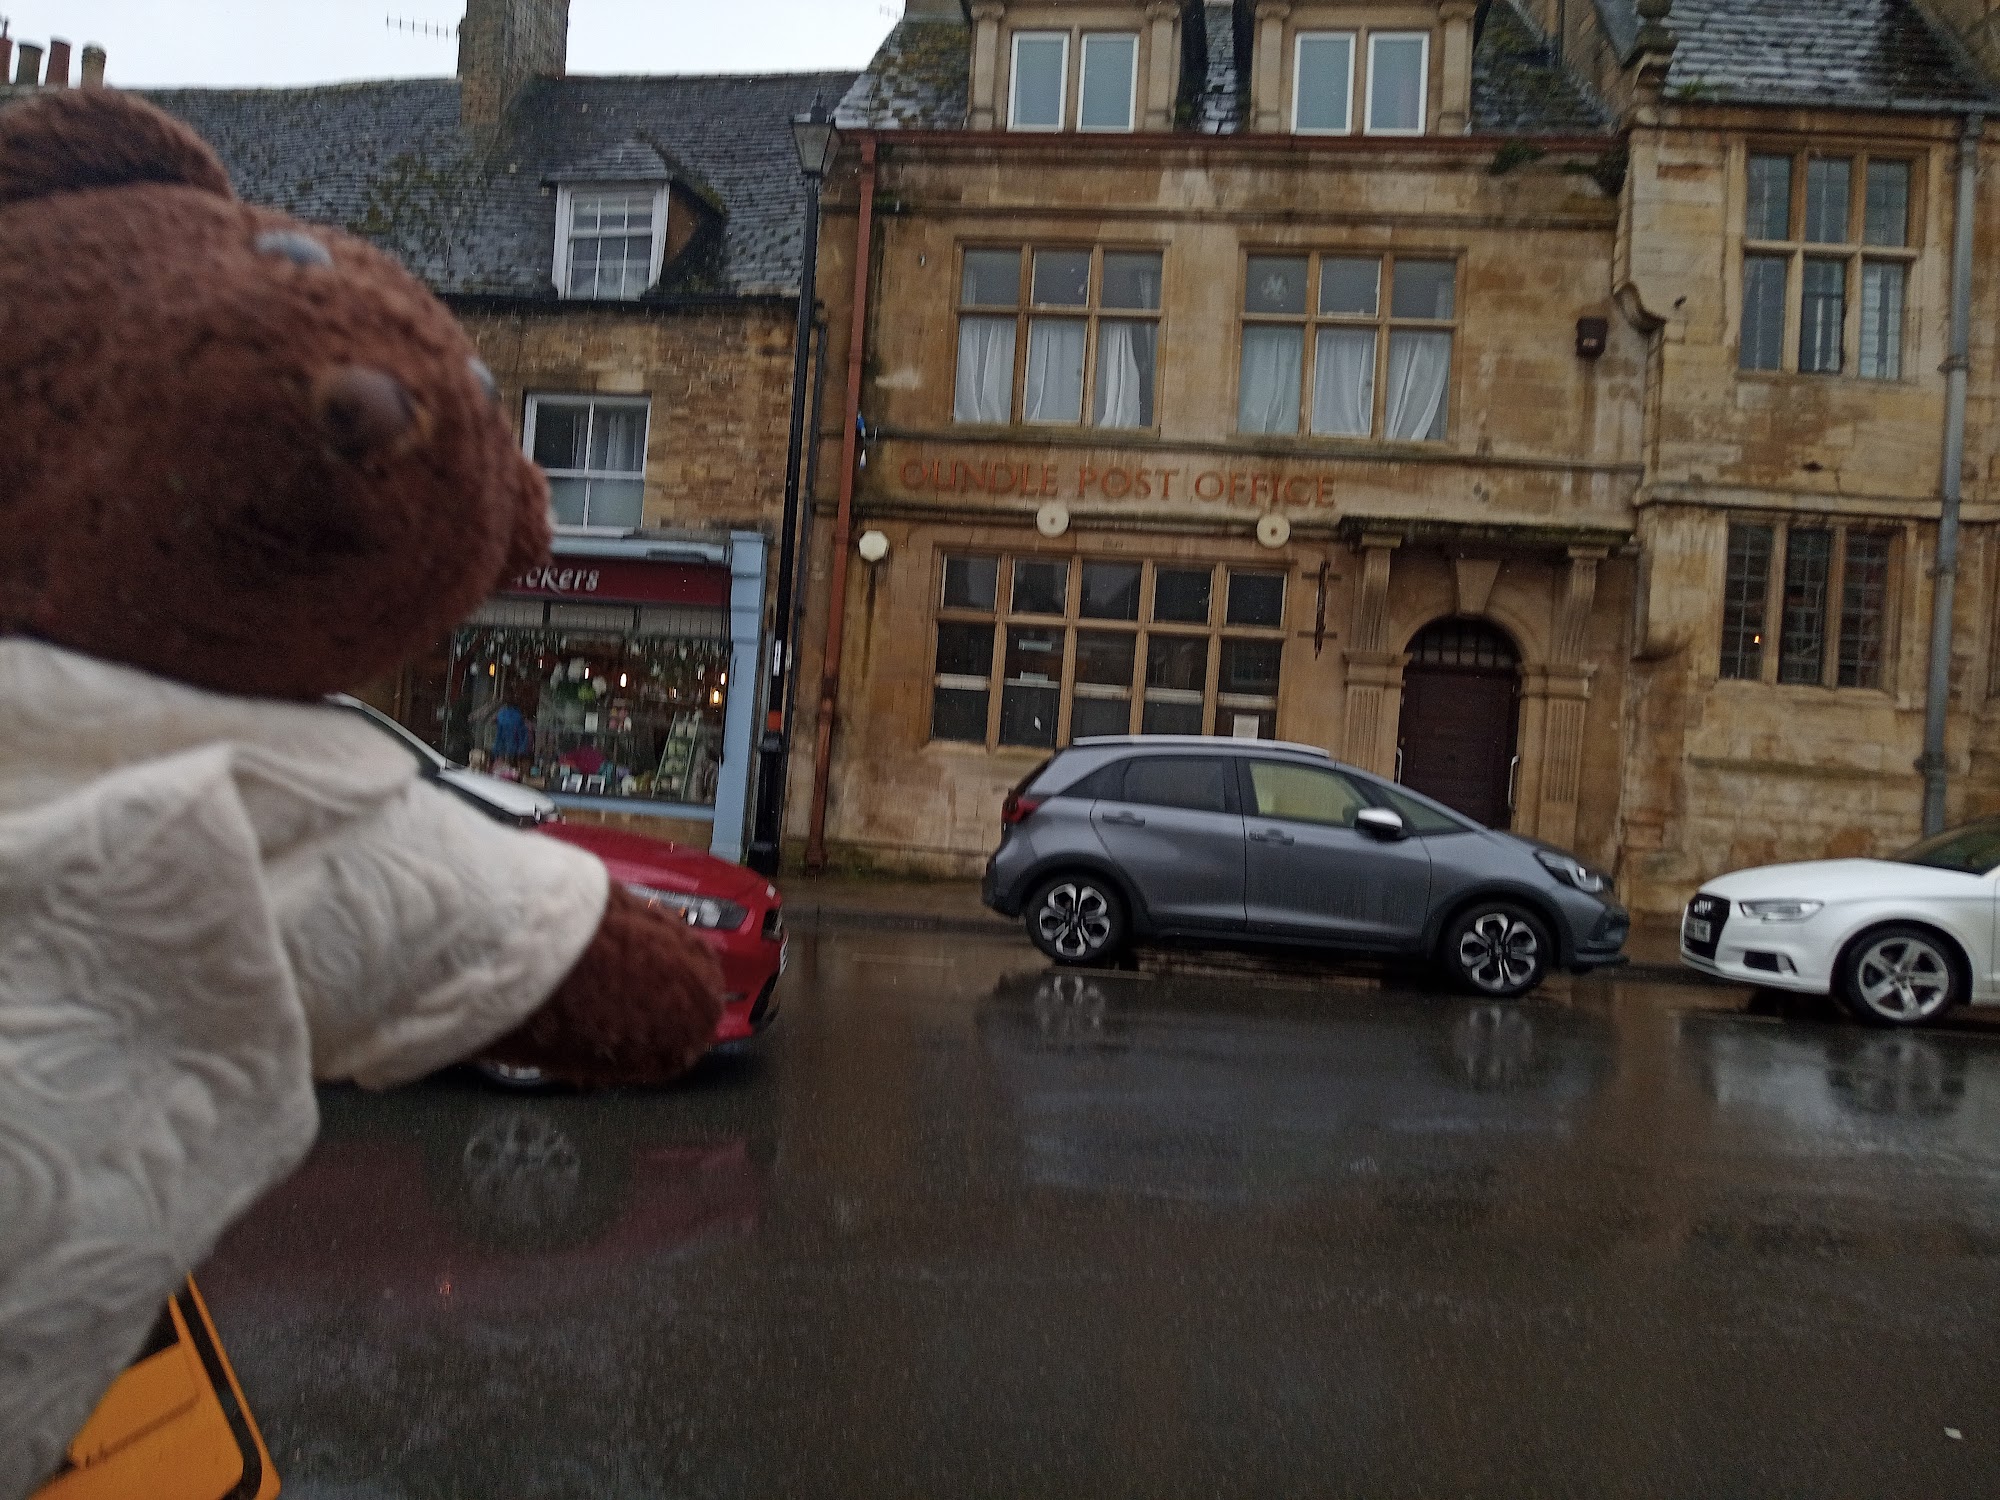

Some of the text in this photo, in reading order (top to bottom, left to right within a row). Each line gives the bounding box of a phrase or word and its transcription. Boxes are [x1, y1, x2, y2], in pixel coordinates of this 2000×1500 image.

[900, 458, 1336, 509] OUNDLE POST OFFICE
